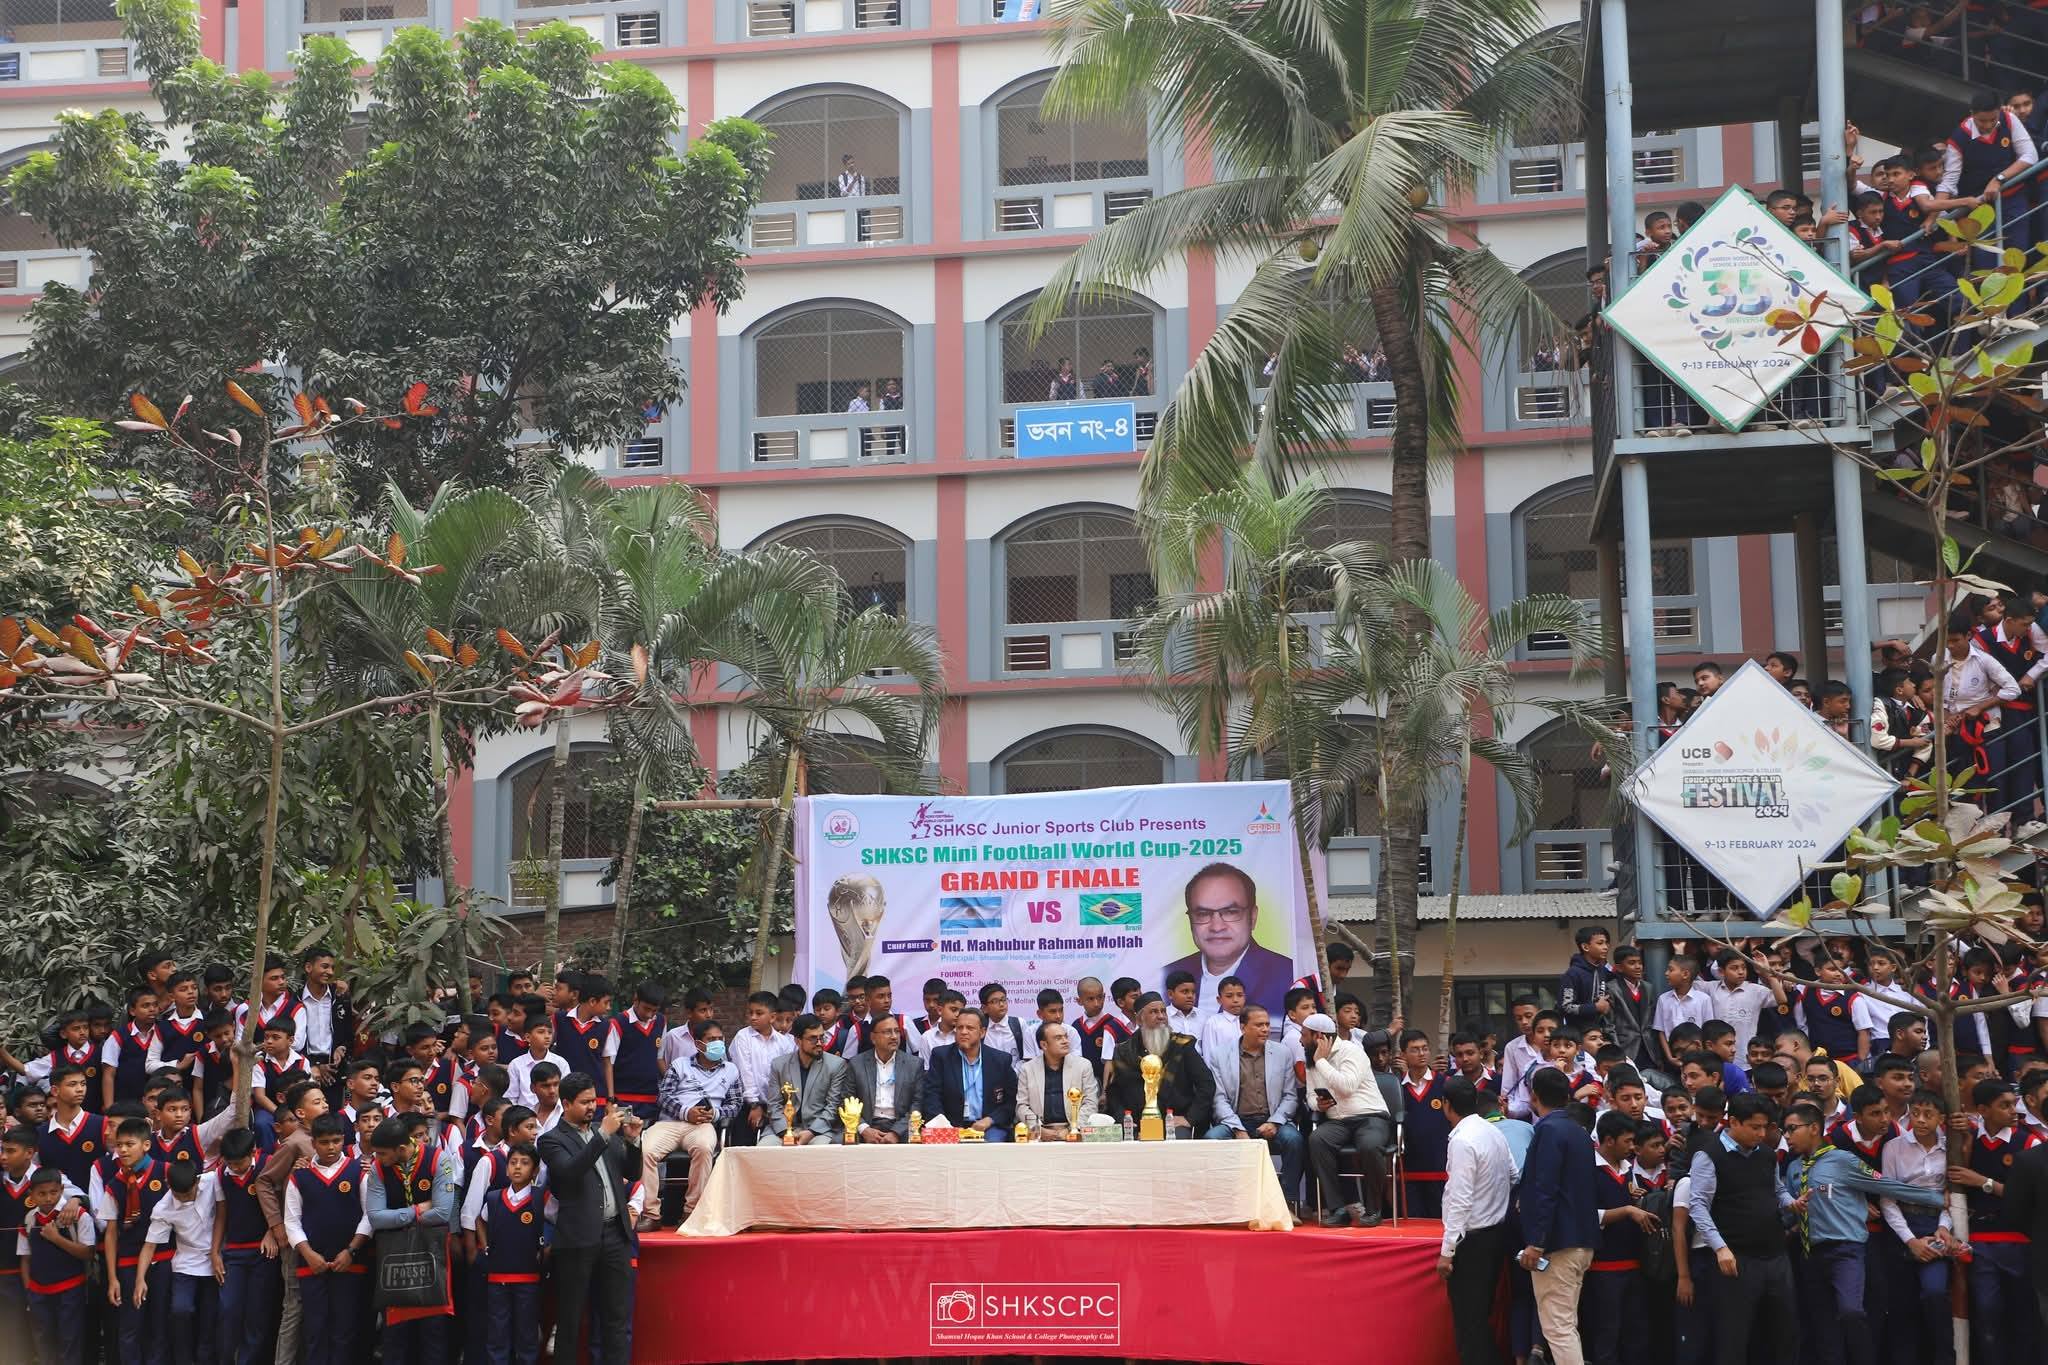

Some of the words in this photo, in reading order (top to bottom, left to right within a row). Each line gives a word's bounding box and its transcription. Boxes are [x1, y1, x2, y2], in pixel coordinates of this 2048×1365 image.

[1700, 269, 1773, 317] 35
[1681, 361, 1703, 370] 9-13
[1705, 360, 1759, 370] FEBRUARY
[1763, 359, 1791, 369] 2024
[1025, 421, 1074, 441] ভবন
[1078, 417, 1128, 441] নং-৪
[1681, 747, 1712, 759] UCB
[1684, 776, 1729, 784] EDUCATION
[1730, 776, 1753, 784] WEEK
[1760, 775, 1782, 784] CLUB
[1683, 783, 1789, 808] FESTIVAL
[1756, 805, 1789, 817] 2024
[933, 823, 987, 837] SHKSC
[992, 820, 1040, 836] Junior
[1045, 819, 1094, 839] Sports
[1100, 818, 1134, 834] Club
[1140, 817, 1206, 832] Presents
[1704, 840, 1727, 849] 9-13
[1729, 840, 1783, 849] FEBRUARY
[1787, 839, 1816, 849] 2024
[861, 847, 928, 865] SHKSC
[933, 845, 977, 863] Mini
[983, 842, 1066, 862] Football
[1071, 840, 1135, 859] World
[1140, 837, 1242, 860] Cup-2025
[940, 870, 1039, 892] GRAND
[1047, 867, 1140, 889] FINALE
[1027, 900, 1062, 923] VS
[887, 943, 906, 951] CHIEF
[907, 941, 929, 950] GUEST
[940, 939, 964, 953] Md.
[967, 937, 1036, 952] Mahbubur
[1038, 936, 1094, 951] Rahman
[1097, 935, 1143, 949] Mollah
[1028, 961, 1036, 970] &
[940, 970, 975, 979] FOUNDER:
[1026, 978, 1053, 986] Mollah
[1053, 977, 1081, 987] Colleg
